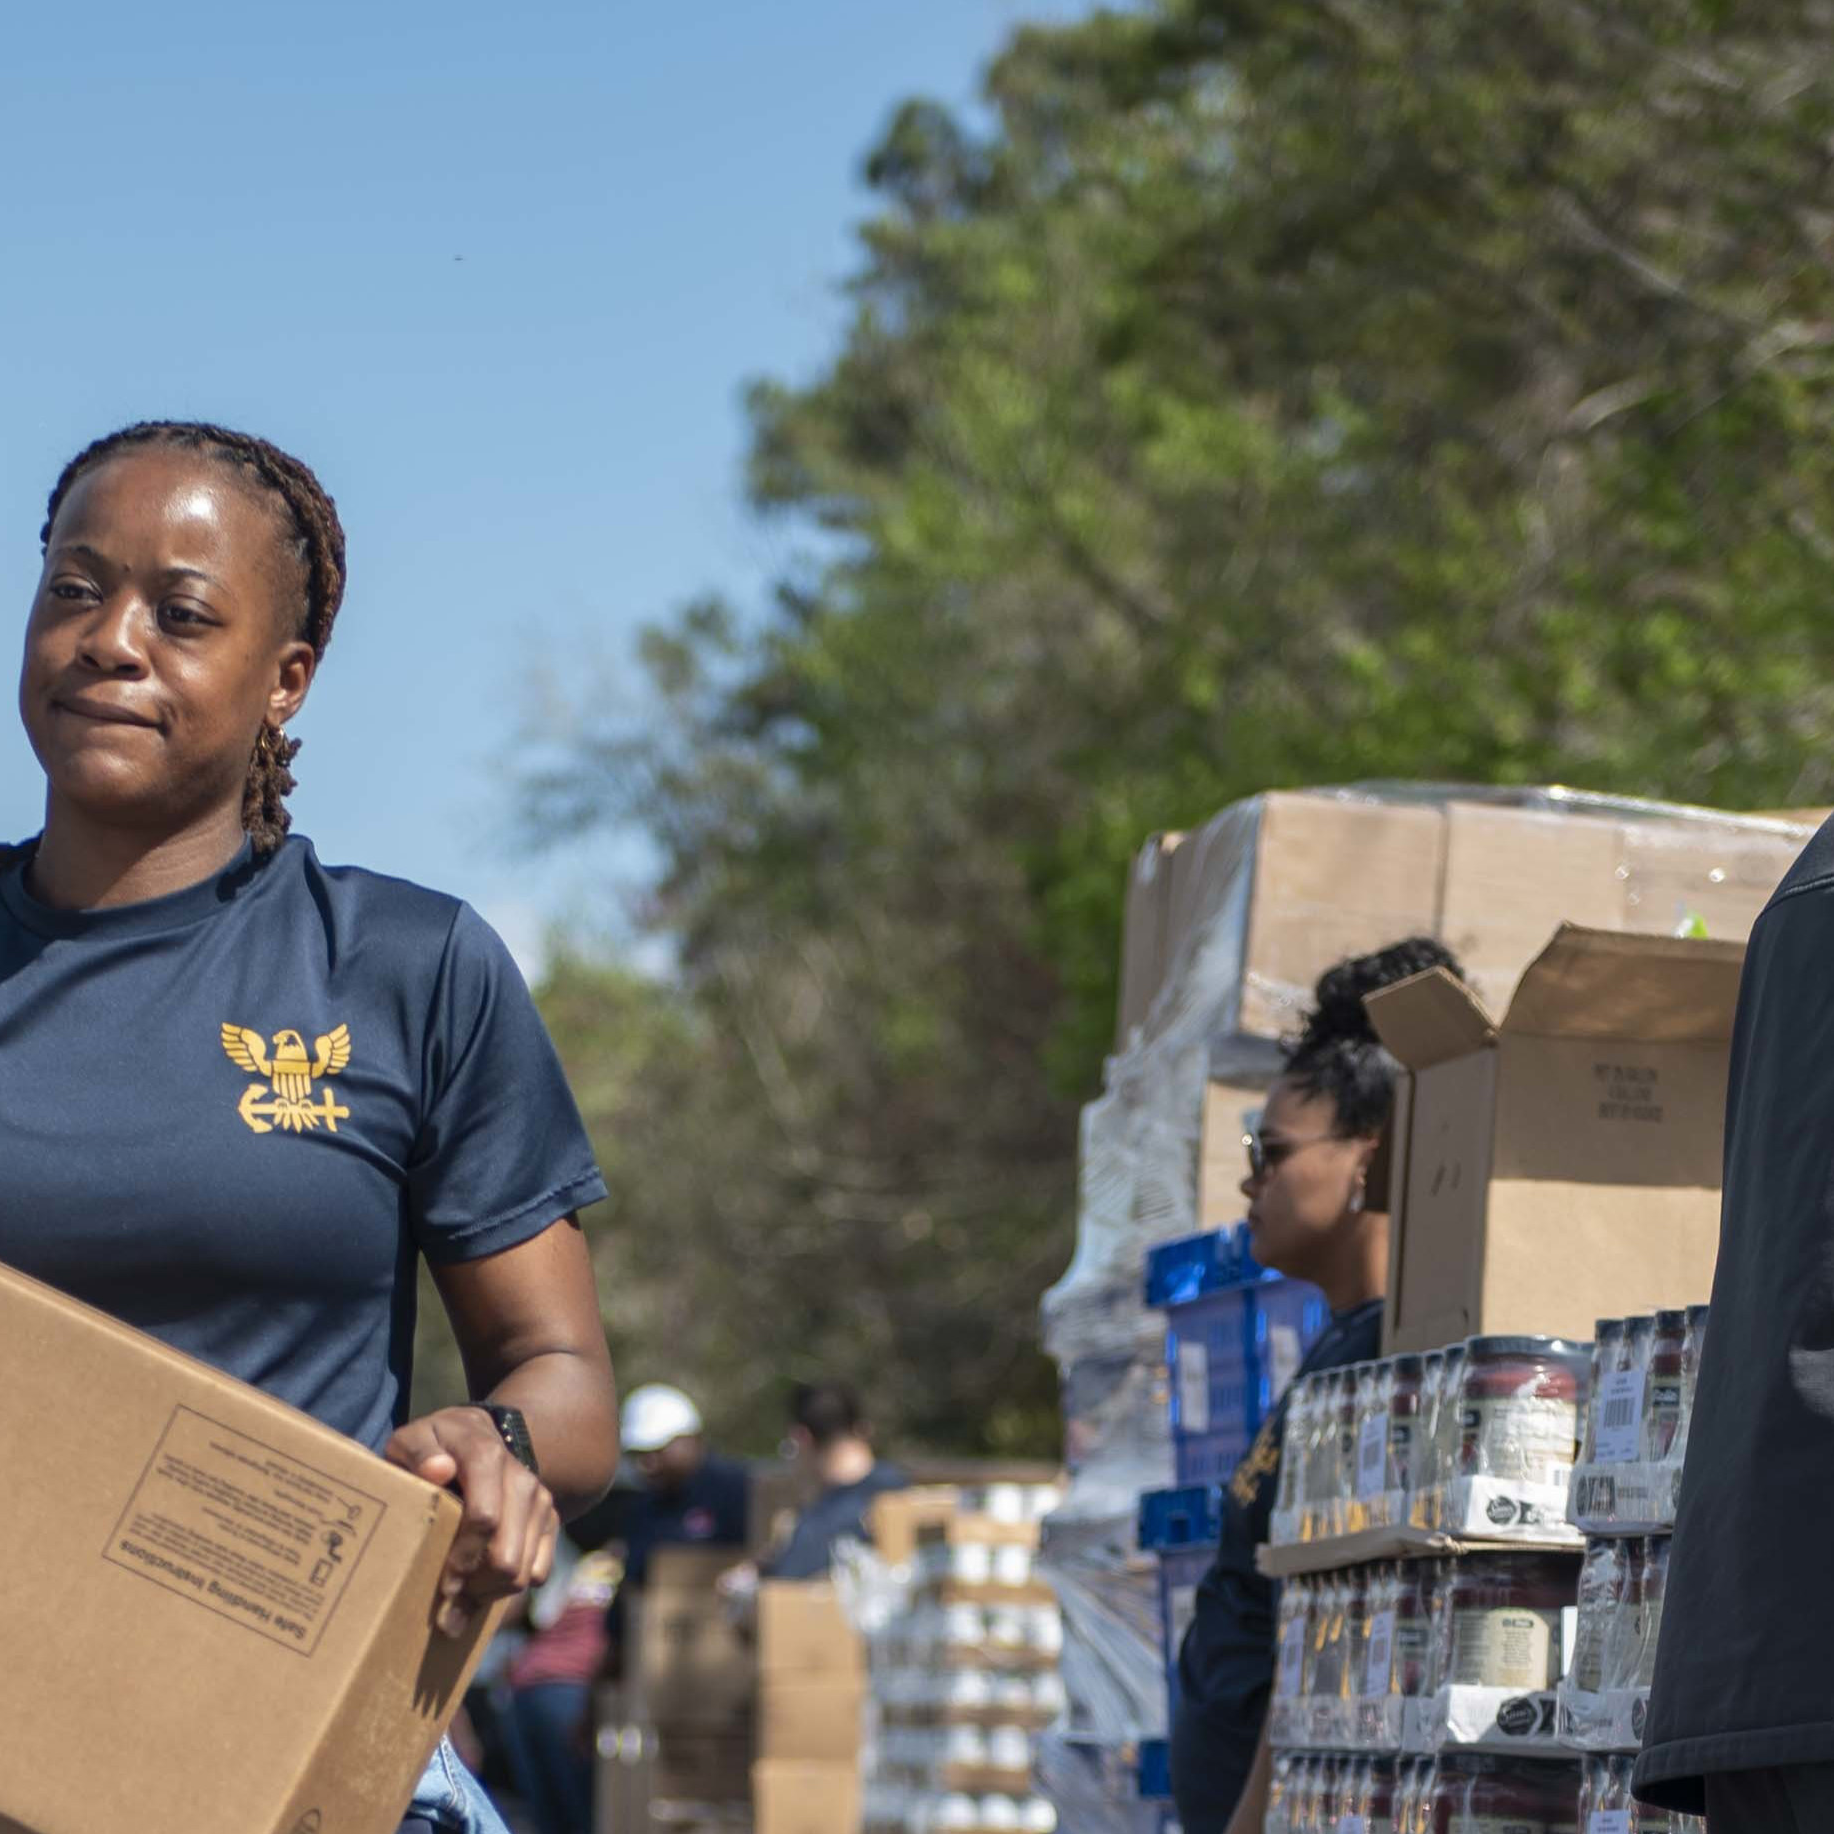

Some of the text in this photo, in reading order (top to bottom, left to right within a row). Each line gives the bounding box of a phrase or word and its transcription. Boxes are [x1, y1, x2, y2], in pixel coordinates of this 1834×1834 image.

[120, 1540, 307, 1640] Safe Handling Instructions
